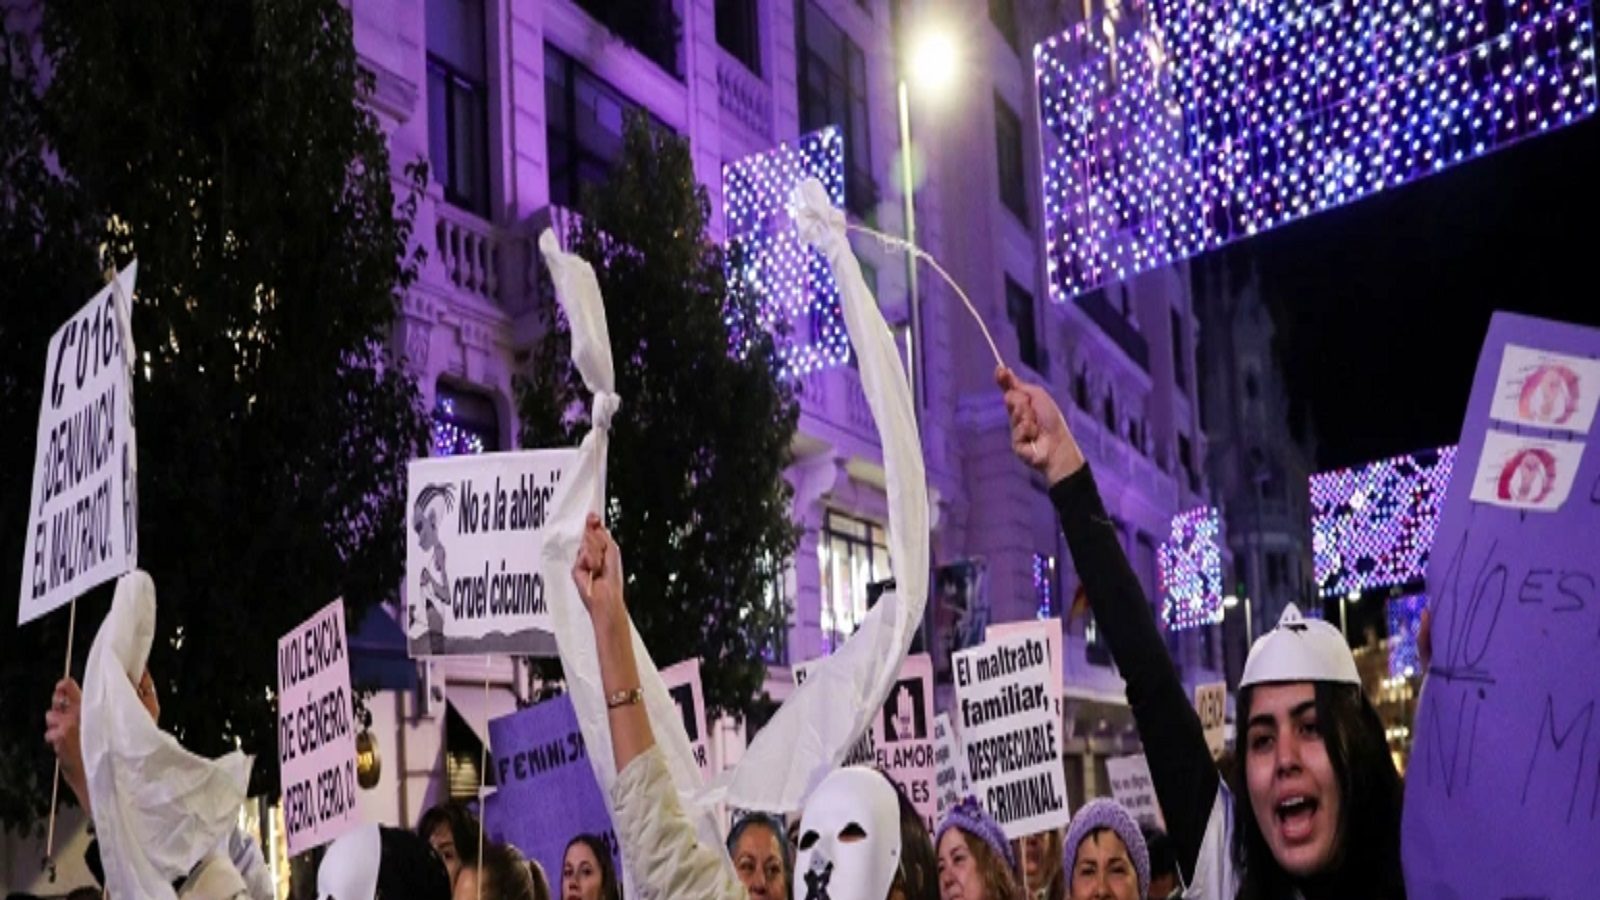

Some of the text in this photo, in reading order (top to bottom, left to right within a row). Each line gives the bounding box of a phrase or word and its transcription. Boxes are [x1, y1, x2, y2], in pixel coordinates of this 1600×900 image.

[458, 470, 561, 535] No a la ablac
[452, 560, 487, 621] cruel
[1432, 529, 1595, 684] NO ES
[279, 612, 344, 691] VIOLENCIA
[957, 655, 971, 688] El
[976, 638, 1043, 682] maltrato
[962, 682, 1049, 728] familiar,
[279, 711, 296, 764] DE
[499, 731, 585, 786] FEMINIS
[876, 748, 891, 769] EL
[893, 744, 934, 769] AMOR
[967, 720, 1057, 783] DESPRECIABLE
[911, 780, 930, 804] ES
[987, 771, 1063, 824] CRIMINAL.
